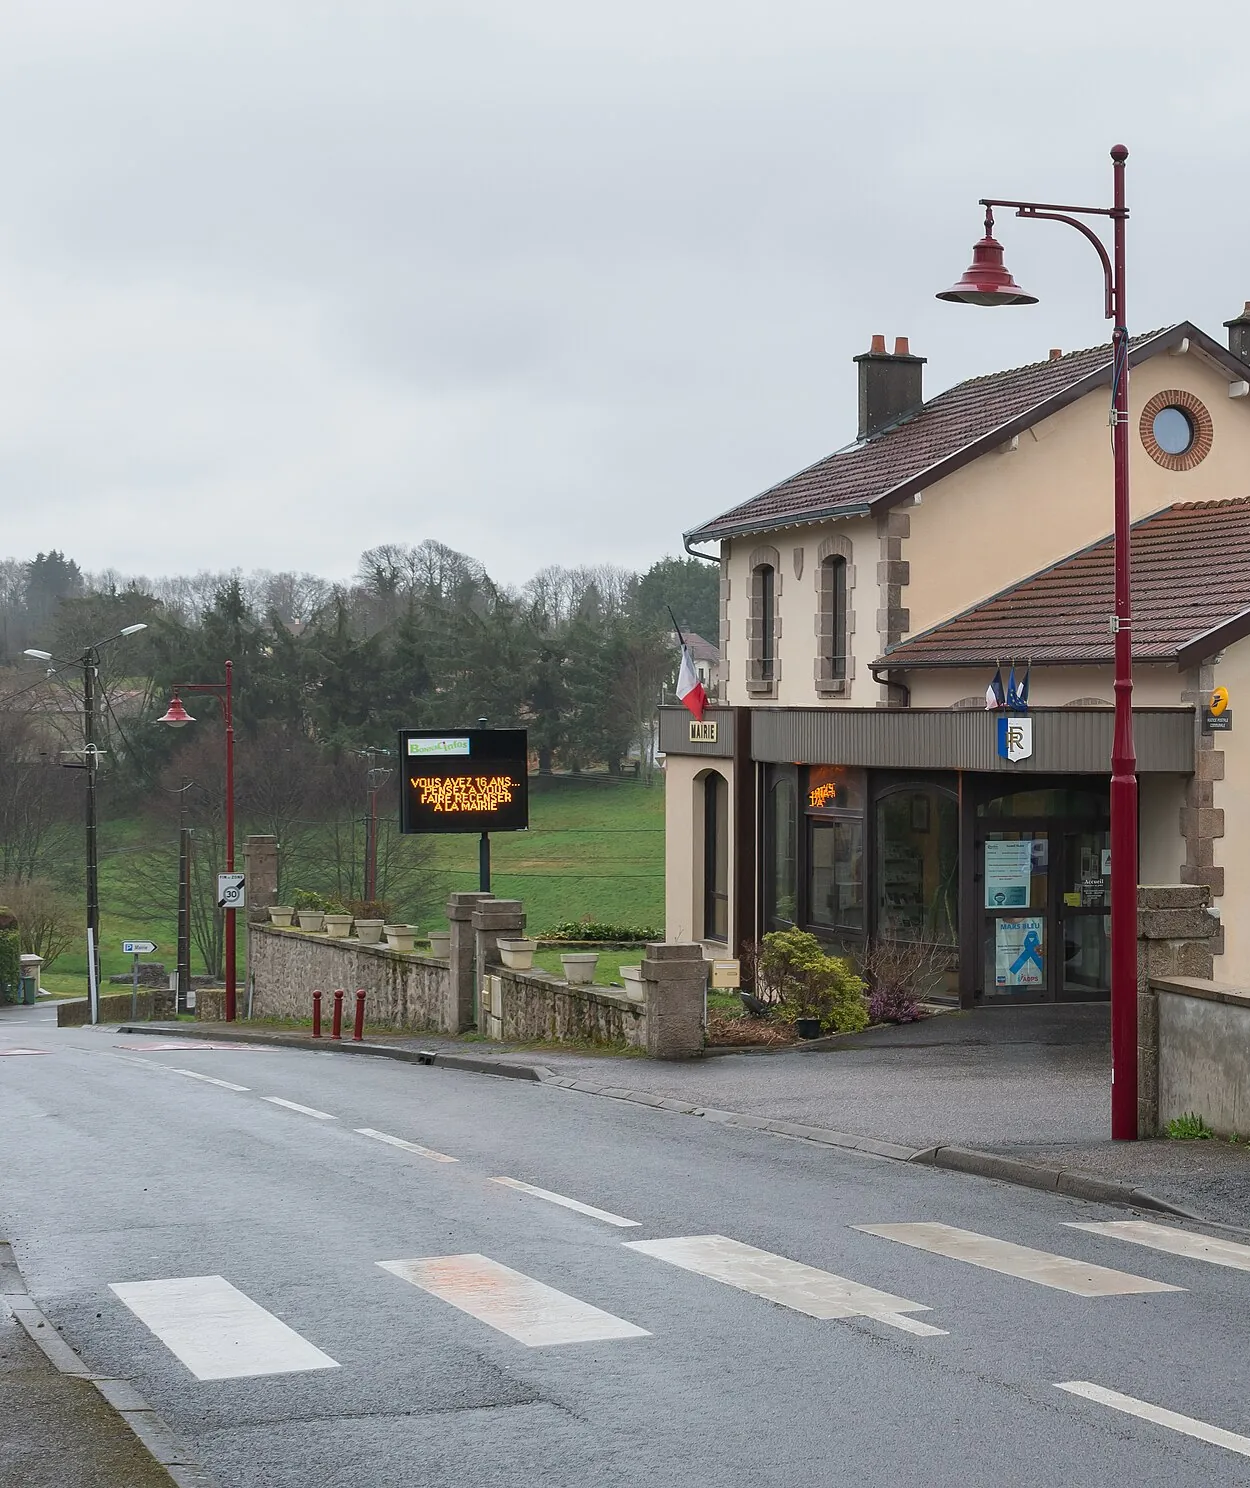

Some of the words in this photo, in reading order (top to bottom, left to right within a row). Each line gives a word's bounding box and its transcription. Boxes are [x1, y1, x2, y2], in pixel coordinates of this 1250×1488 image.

[690, 724, 715, 740] MAIRIE
[410, 778, 442, 788] VOUS
[444, 777, 472, 788] AVEZ
[475, 777, 487, 787] 16
[424, 786, 465, 795] PENSEZ
[478, 785, 509, 795] VOUS
[421, 794, 452, 804] FAIRE
[454, 793, 512, 803] RECENSER
[444, 802, 460, 811] LA
[461, 801, 498, 811] MAIRIE
[226, 890, 237, 898] 30
